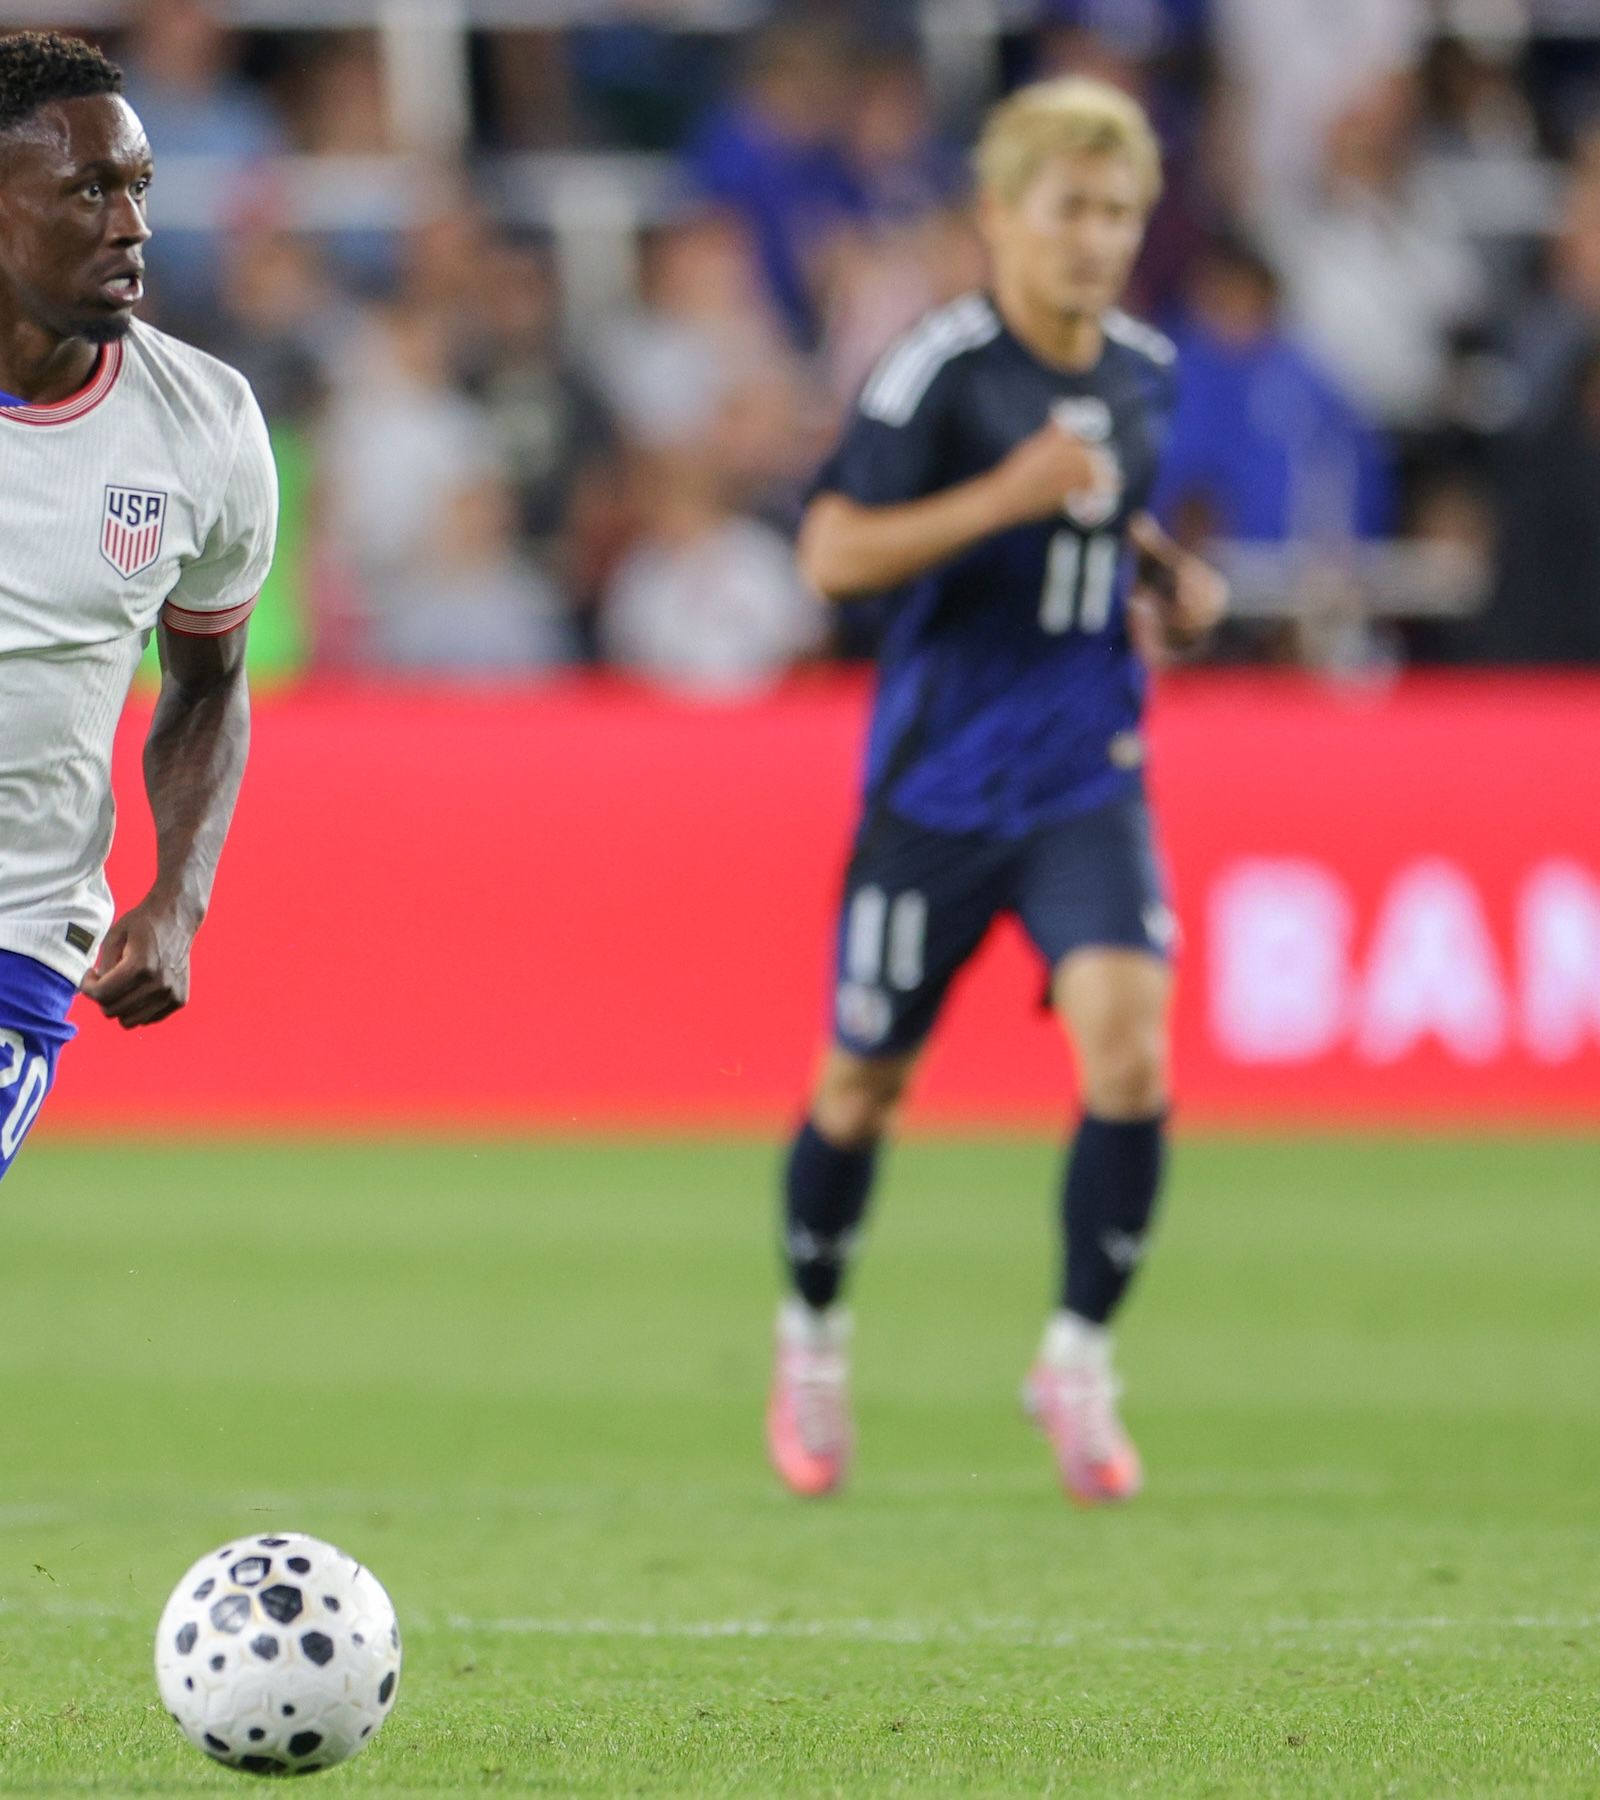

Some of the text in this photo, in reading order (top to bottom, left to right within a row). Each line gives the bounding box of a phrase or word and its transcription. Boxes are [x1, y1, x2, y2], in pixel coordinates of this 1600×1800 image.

[109, 492, 161, 527] USA
[1038, 529, 1116, 635] 11
[848, 884, 928, 991] 11
